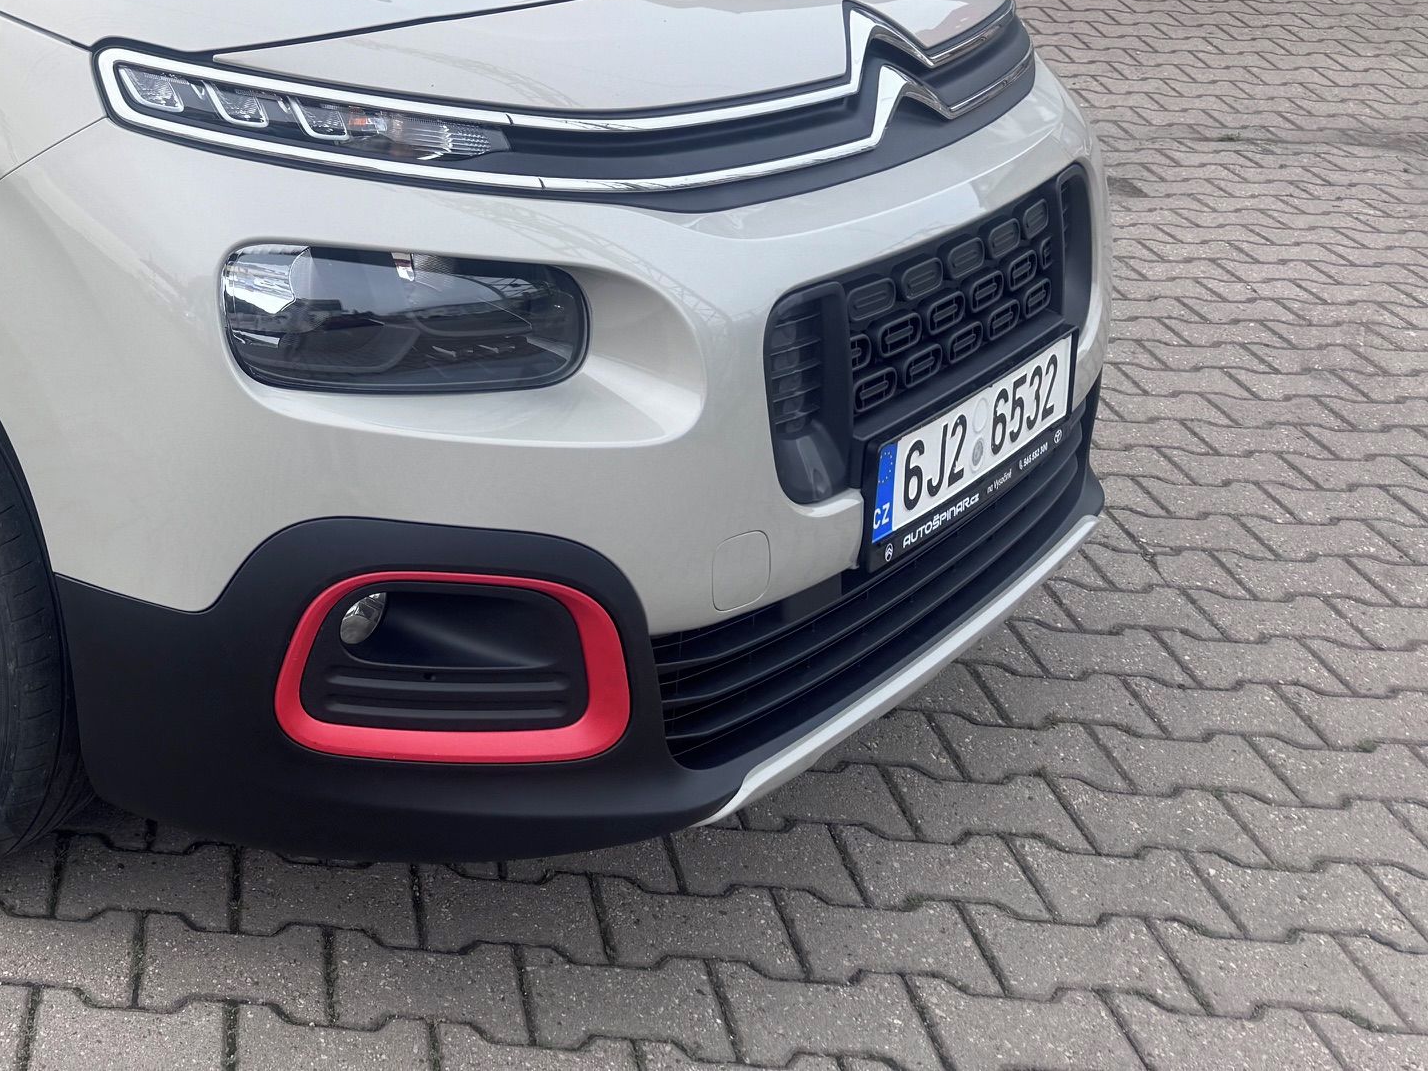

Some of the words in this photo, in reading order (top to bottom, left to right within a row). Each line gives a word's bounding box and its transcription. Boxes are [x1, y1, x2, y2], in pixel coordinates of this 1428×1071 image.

[903, 414, 968, 511] 6J2
[990, 354, 1058, 455] 6532
[873, 502, 890, 529] CZ
